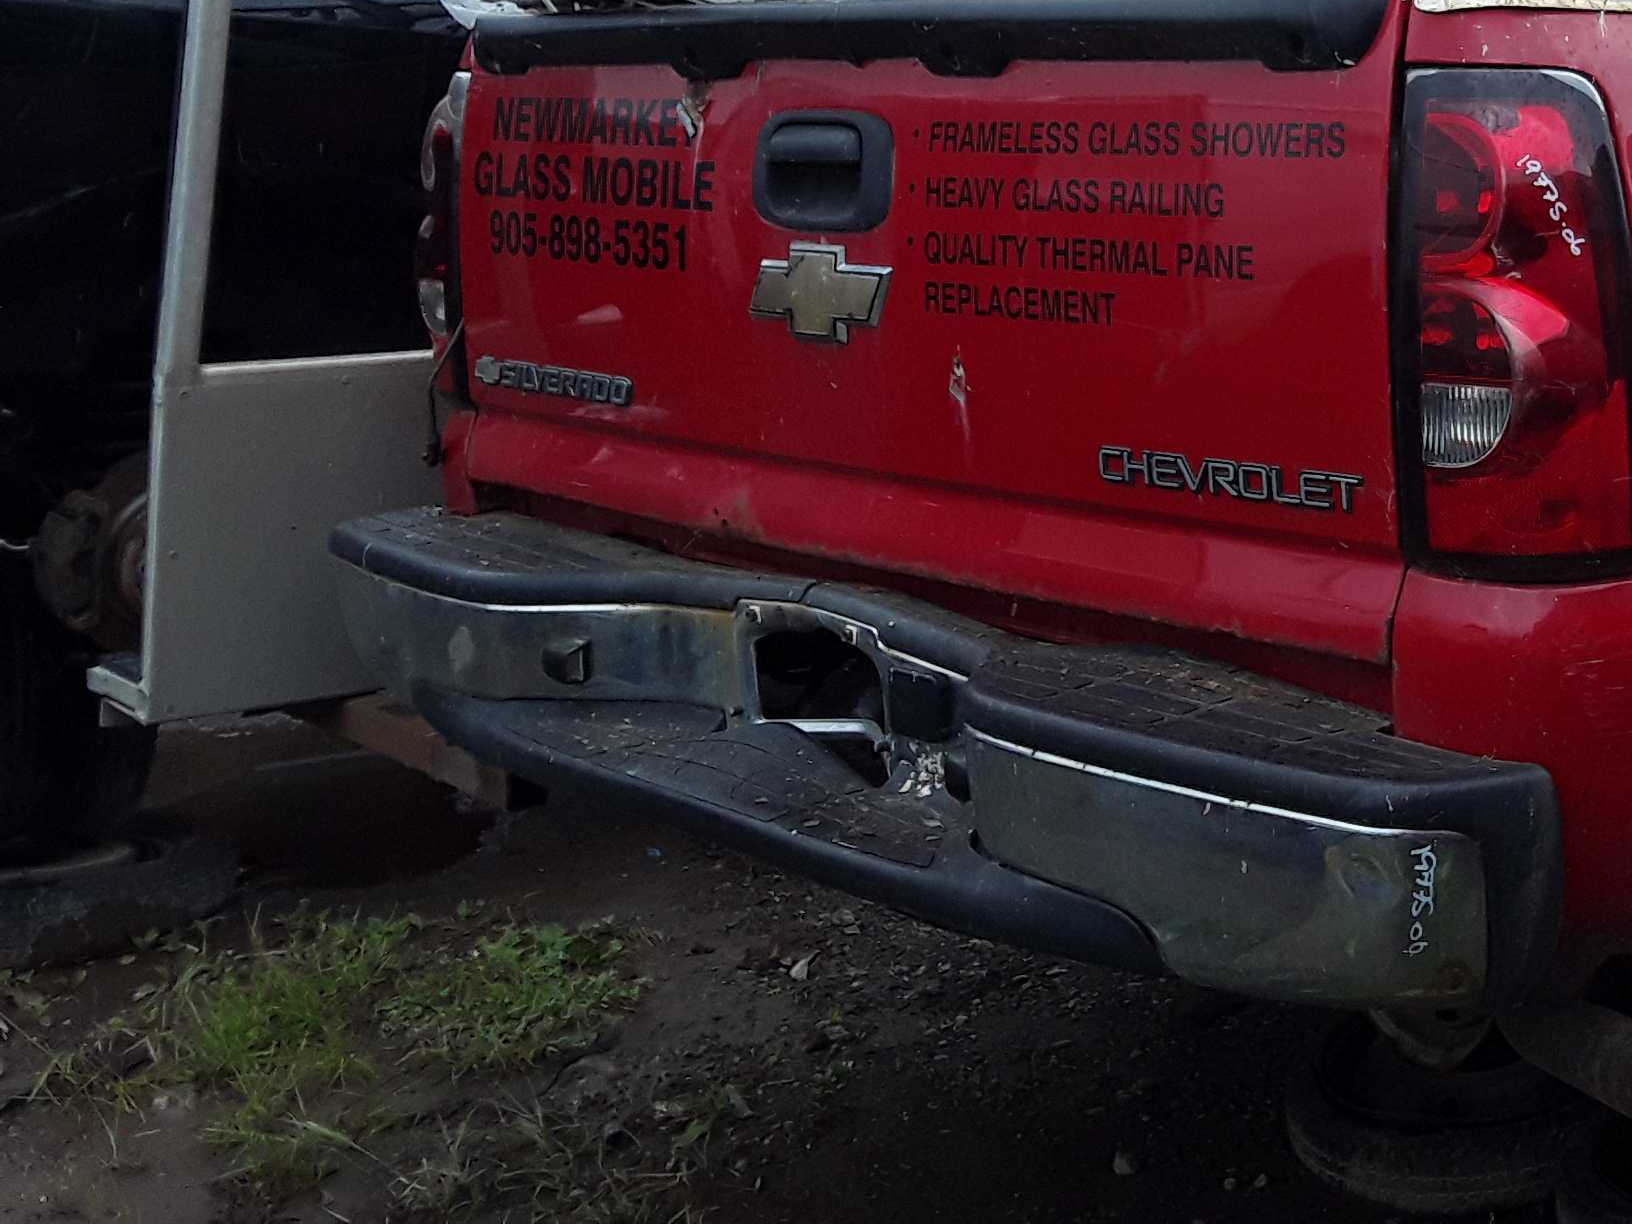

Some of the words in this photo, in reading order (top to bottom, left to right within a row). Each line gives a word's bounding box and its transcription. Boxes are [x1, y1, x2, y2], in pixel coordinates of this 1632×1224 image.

[492, 96, 699, 147] NEWMARKE
[928, 120, 1080, 155] FRAMELESS
[1088, 121, 1181, 158] GLASS
[1190, 121, 1347, 160] SHOWERS
[474, 151, 571, 202] GLASS
[582, 156, 716, 212] MOBILE
[925, 176, 1005, 210] HEAVY
[1013, 177, 1100, 214] GLASS
[1109, 181, 1225, 218] RAILING
[489, 210, 688, 271] 905-898-5351
[923, 231, 1029, 267] QUALITY
[1036, 235, 1168, 277] THERMAL
[1176, 241, 1255, 280] PANE
[924, 280, 1116, 326] REPLACEMENT
[499, 359, 634, 406] SILVERADO
[1098, 444, 1364, 514] CHEVROLET
